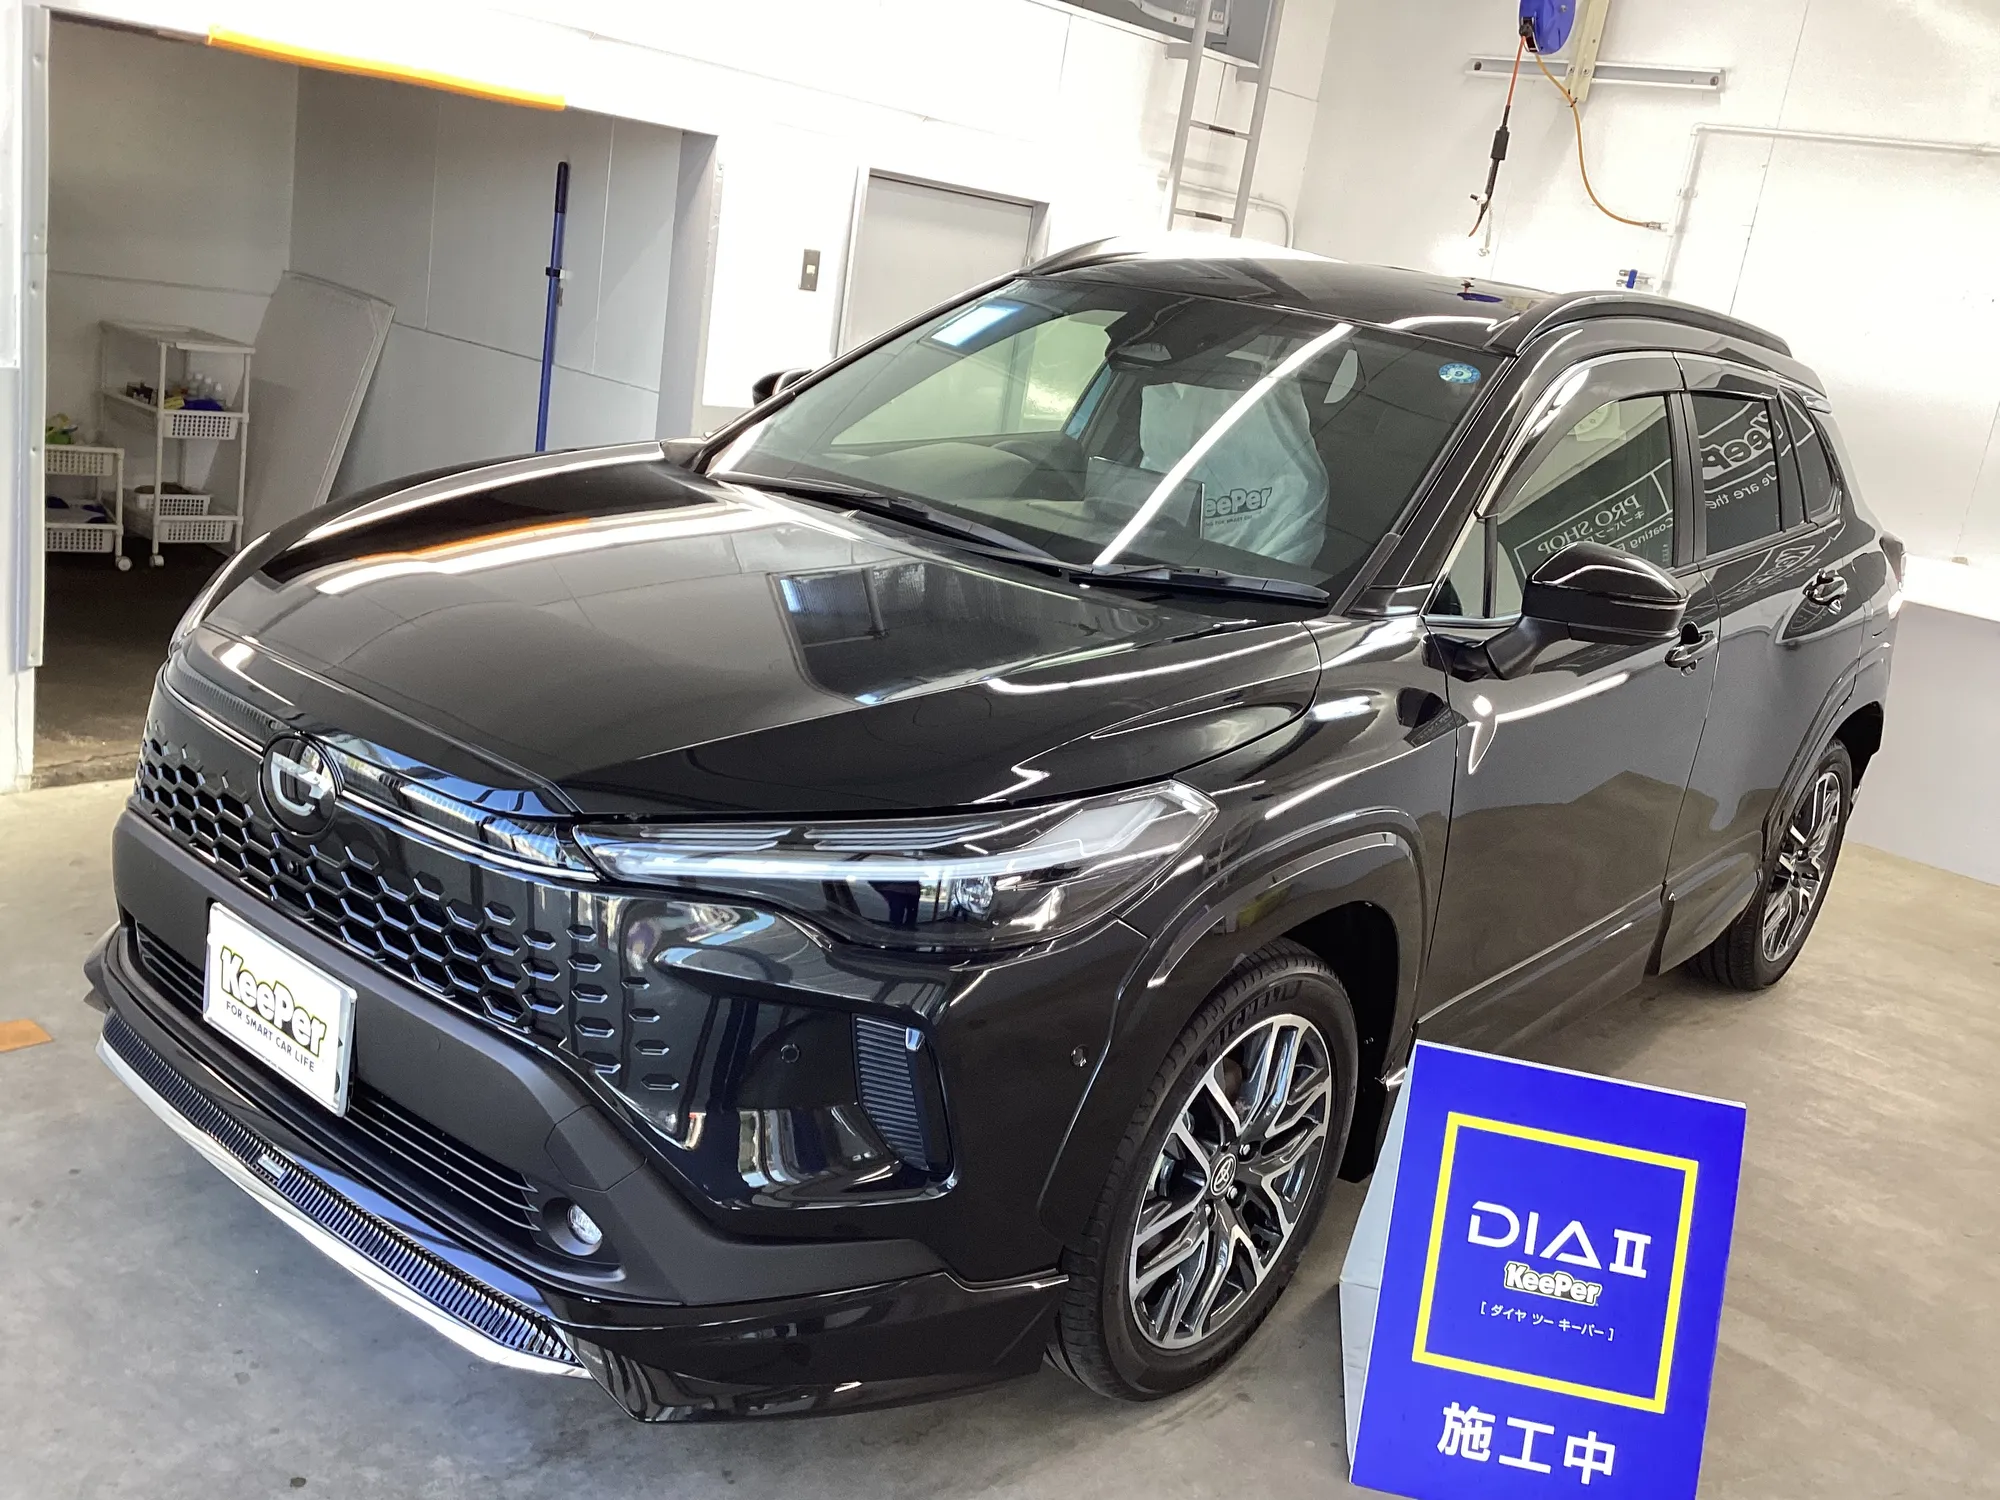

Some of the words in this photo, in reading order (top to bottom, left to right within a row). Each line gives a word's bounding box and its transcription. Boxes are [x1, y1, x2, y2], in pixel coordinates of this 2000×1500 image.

[1204, 486, 1273, 519] eePer
[220, 945, 327, 1057] KeePer
[226, 1000, 242, 1019] FOR
[246, 1014, 273, 1042] SMART
[275, 1036, 292, 1055] CAR
[294, 1050, 315, 1073] LIFE
[1467, 1200, 1602, 1270] DIA
[1504, 1260, 1603, 1306] KeePer
[1437, 1401, 1616, 1486] 施工中
